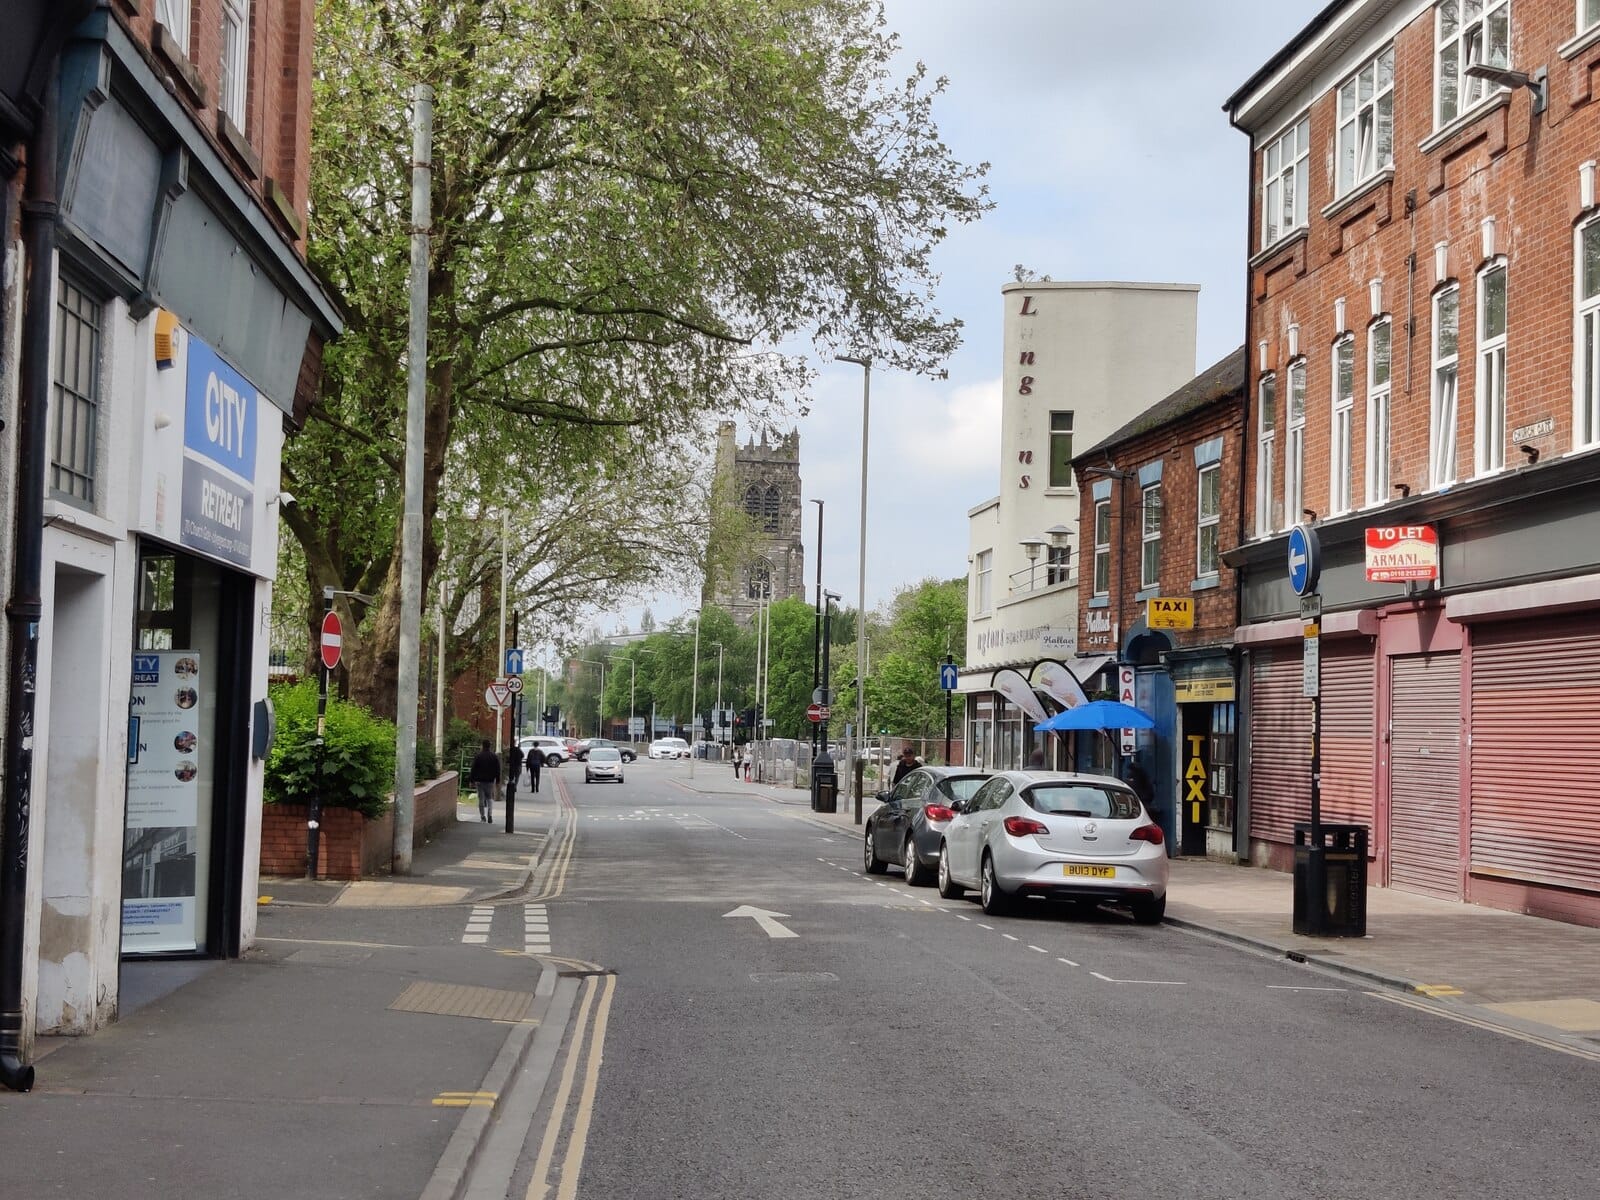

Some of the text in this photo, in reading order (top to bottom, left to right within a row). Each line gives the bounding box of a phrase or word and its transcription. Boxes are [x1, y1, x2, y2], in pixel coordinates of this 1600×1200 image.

[1017, 296, 1037, 489] Lngns
[205, 371, 247, 459] CITY
[201, 479, 244, 532] RETREAT
[1377, 527, 1424, 540] TO LET
[1372, 553, 1417, 567] ARMANI
[1154, 601, 1187, 611] TAXI
[1089, 636, 1108, 644] CAFE
[509, 681, 521, 689] 20
[1121, 670, 1134, 737] CAE
[1185, 735, 1207, 823] TAXI
[1069, 865, 1110, 876] BU13 DYF
